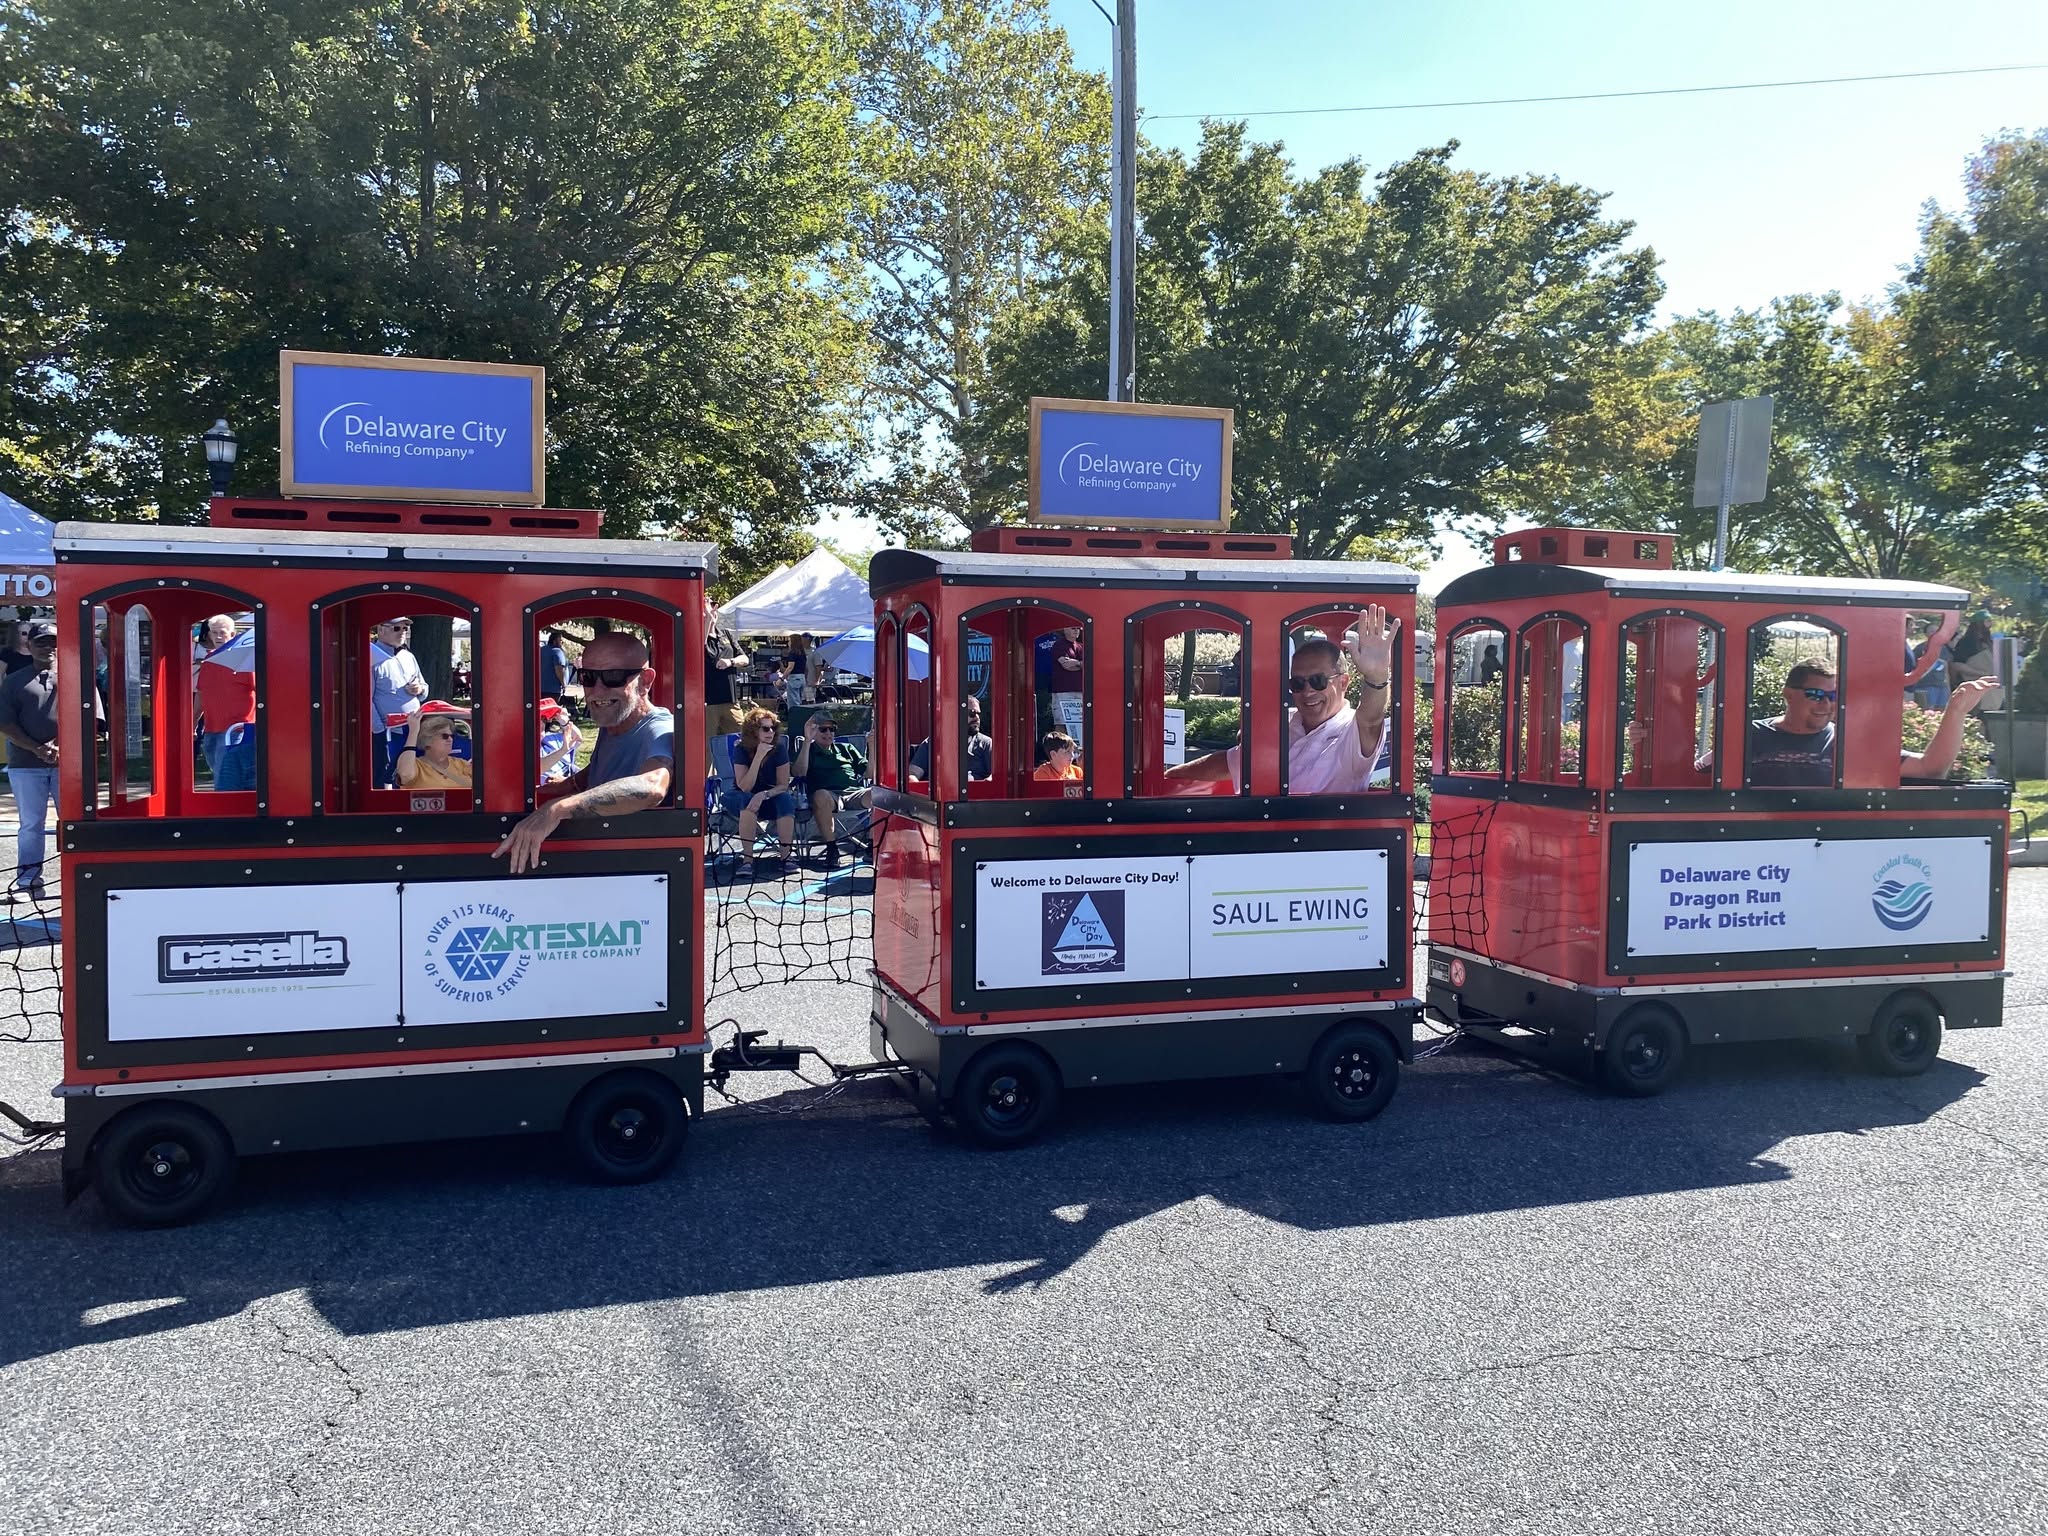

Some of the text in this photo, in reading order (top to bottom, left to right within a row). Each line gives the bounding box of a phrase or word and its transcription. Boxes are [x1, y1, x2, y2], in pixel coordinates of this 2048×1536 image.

[344, 414, 507, 449] Delaware City
[345, 440, 401, 458] Refining
[1078, 453, 1202, 482] Delaware City
[1078, 476, 1121, 491] Refining
[0, 573, 57, 597] TTO
[968, 645, 992, 662] WAR
[1660, 864, 1791, 884] Delaware City
[1872, 855, 1901, 883] Coastal
[1902, 853, 1922, 869] Bath
[990, 871, 1180, 888] Welcome to Delaware City Day!
[1669, 888, 1781, 910] Dragon Run
[1212, 897, 1369, 926] SAUL EWING
[1663, 910, 1786, 930] Park District
[427, 903, 515, 944] OVER 115 YEARS
[1086, 932, 1103, 943] Day
[168, 933, 346, 972] casella
[537, 947, 642, 961] WATER COMPANY
[424, 953, 532, 1003] OF SUPERIOR SERVICE
[208, 986, 277, 996] ESTABLISHED
